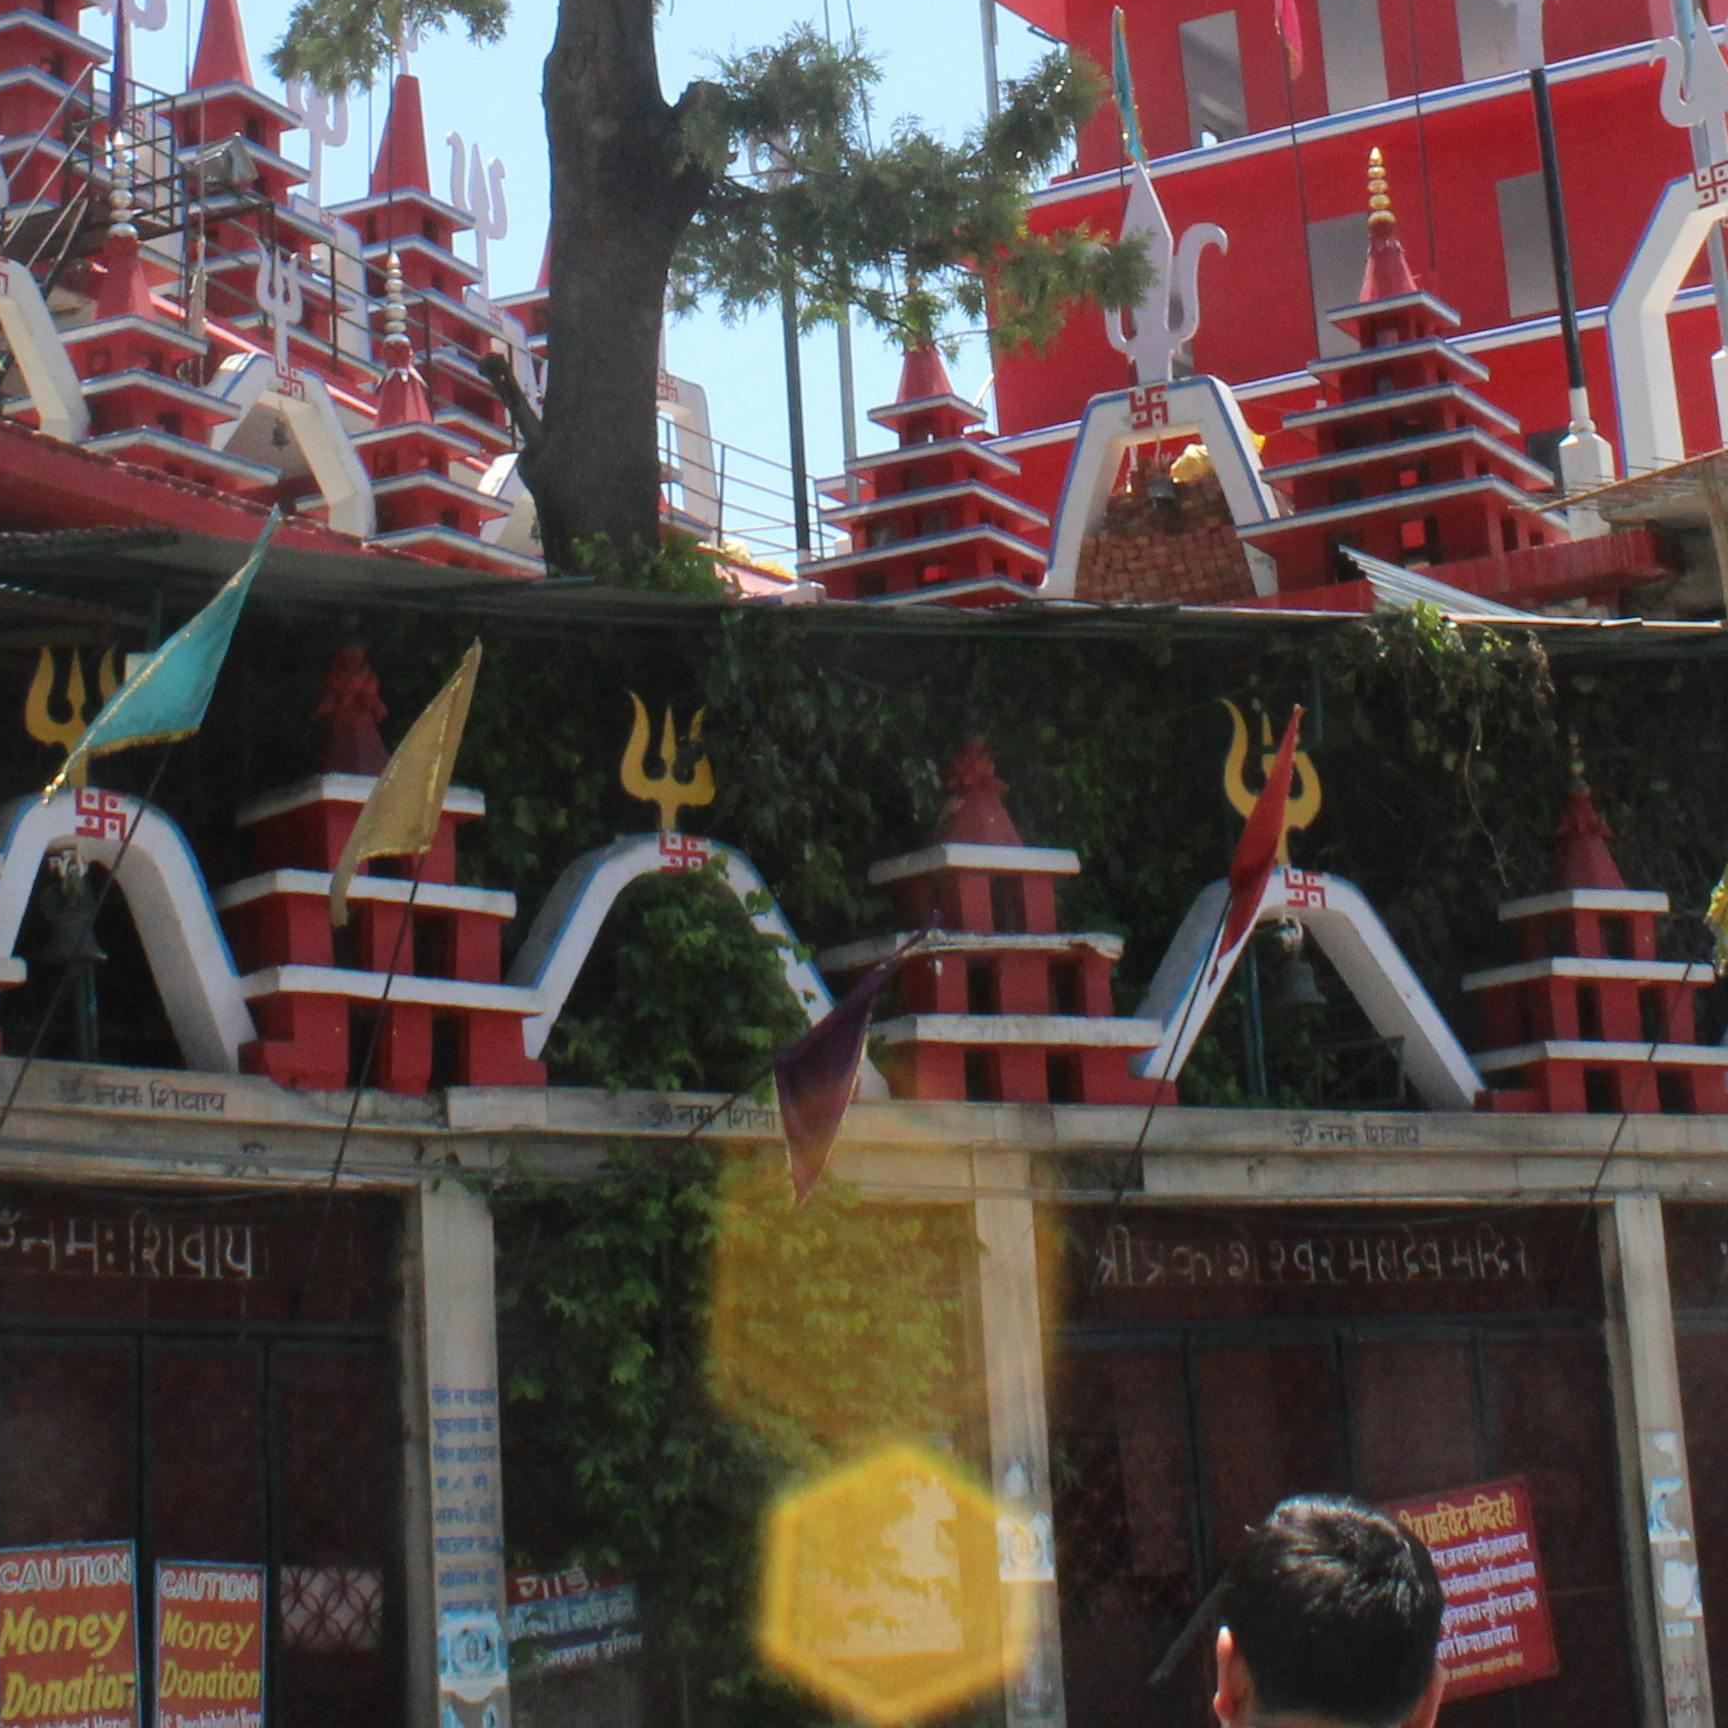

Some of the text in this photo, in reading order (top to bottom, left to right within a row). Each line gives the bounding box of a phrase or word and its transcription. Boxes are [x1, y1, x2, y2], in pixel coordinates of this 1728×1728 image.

[160, 1571, 259, 1601] CAUTION
[160, 1610, 255, 1656] Money
[1, 1664, 138, 1720] Donation
[160, 1660, 261, 1700] Donation
